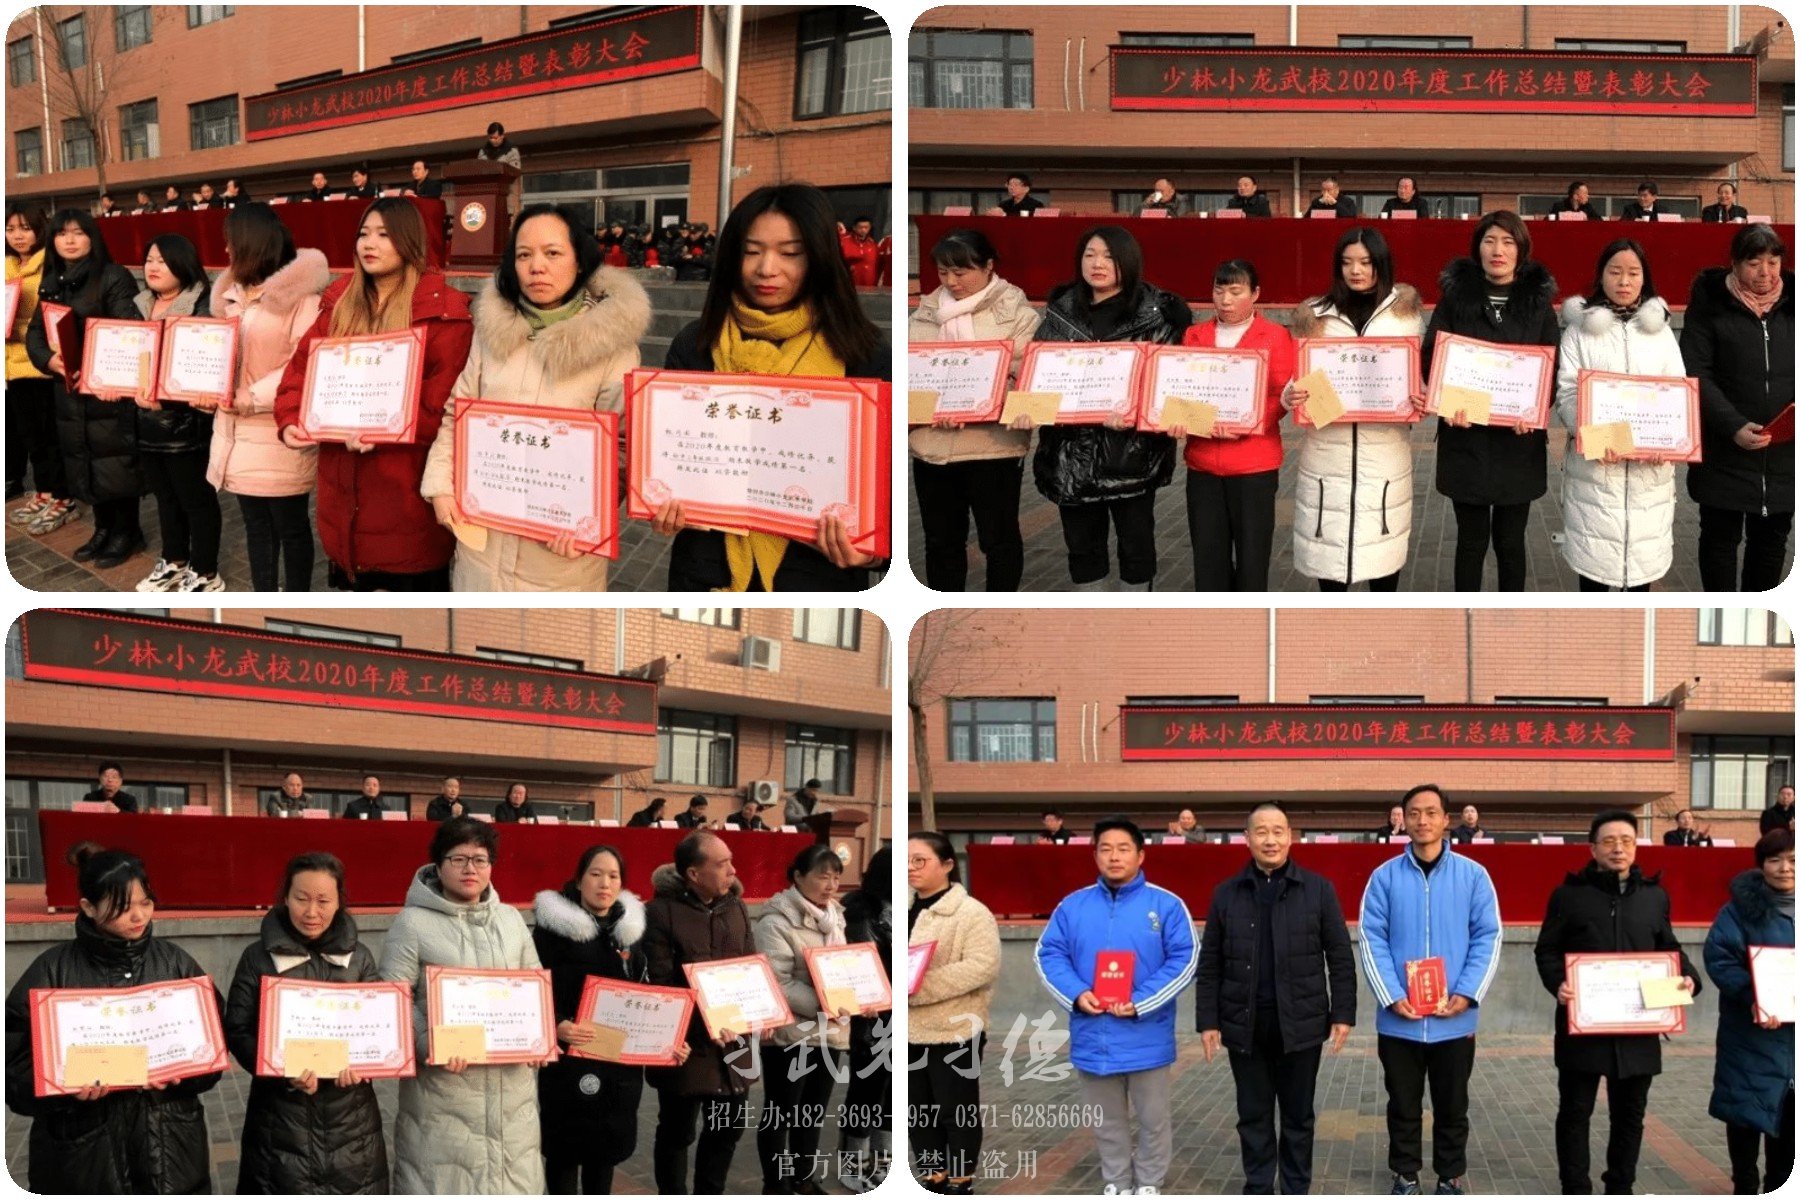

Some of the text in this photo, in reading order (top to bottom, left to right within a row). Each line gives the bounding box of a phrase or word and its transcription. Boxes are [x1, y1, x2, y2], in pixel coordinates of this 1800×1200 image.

[267, 30, 650, 126] 少林小龙武校2020年度工作总结暨表彰大会
[1160, 66, 1712, 98] 少林小龙武校2020年度工作总结暨表彰大会
[704, 401, 784, 424] 荣誉证书
[500, 428, 552, 450] 荣誉证书
[92, 633, 627, 716] 少林小龙武校2020年度工作总结暨表彰大会
[1164, 720, 1637, 746] 少林小龙武校2020年度工作总结暨表彰大会
